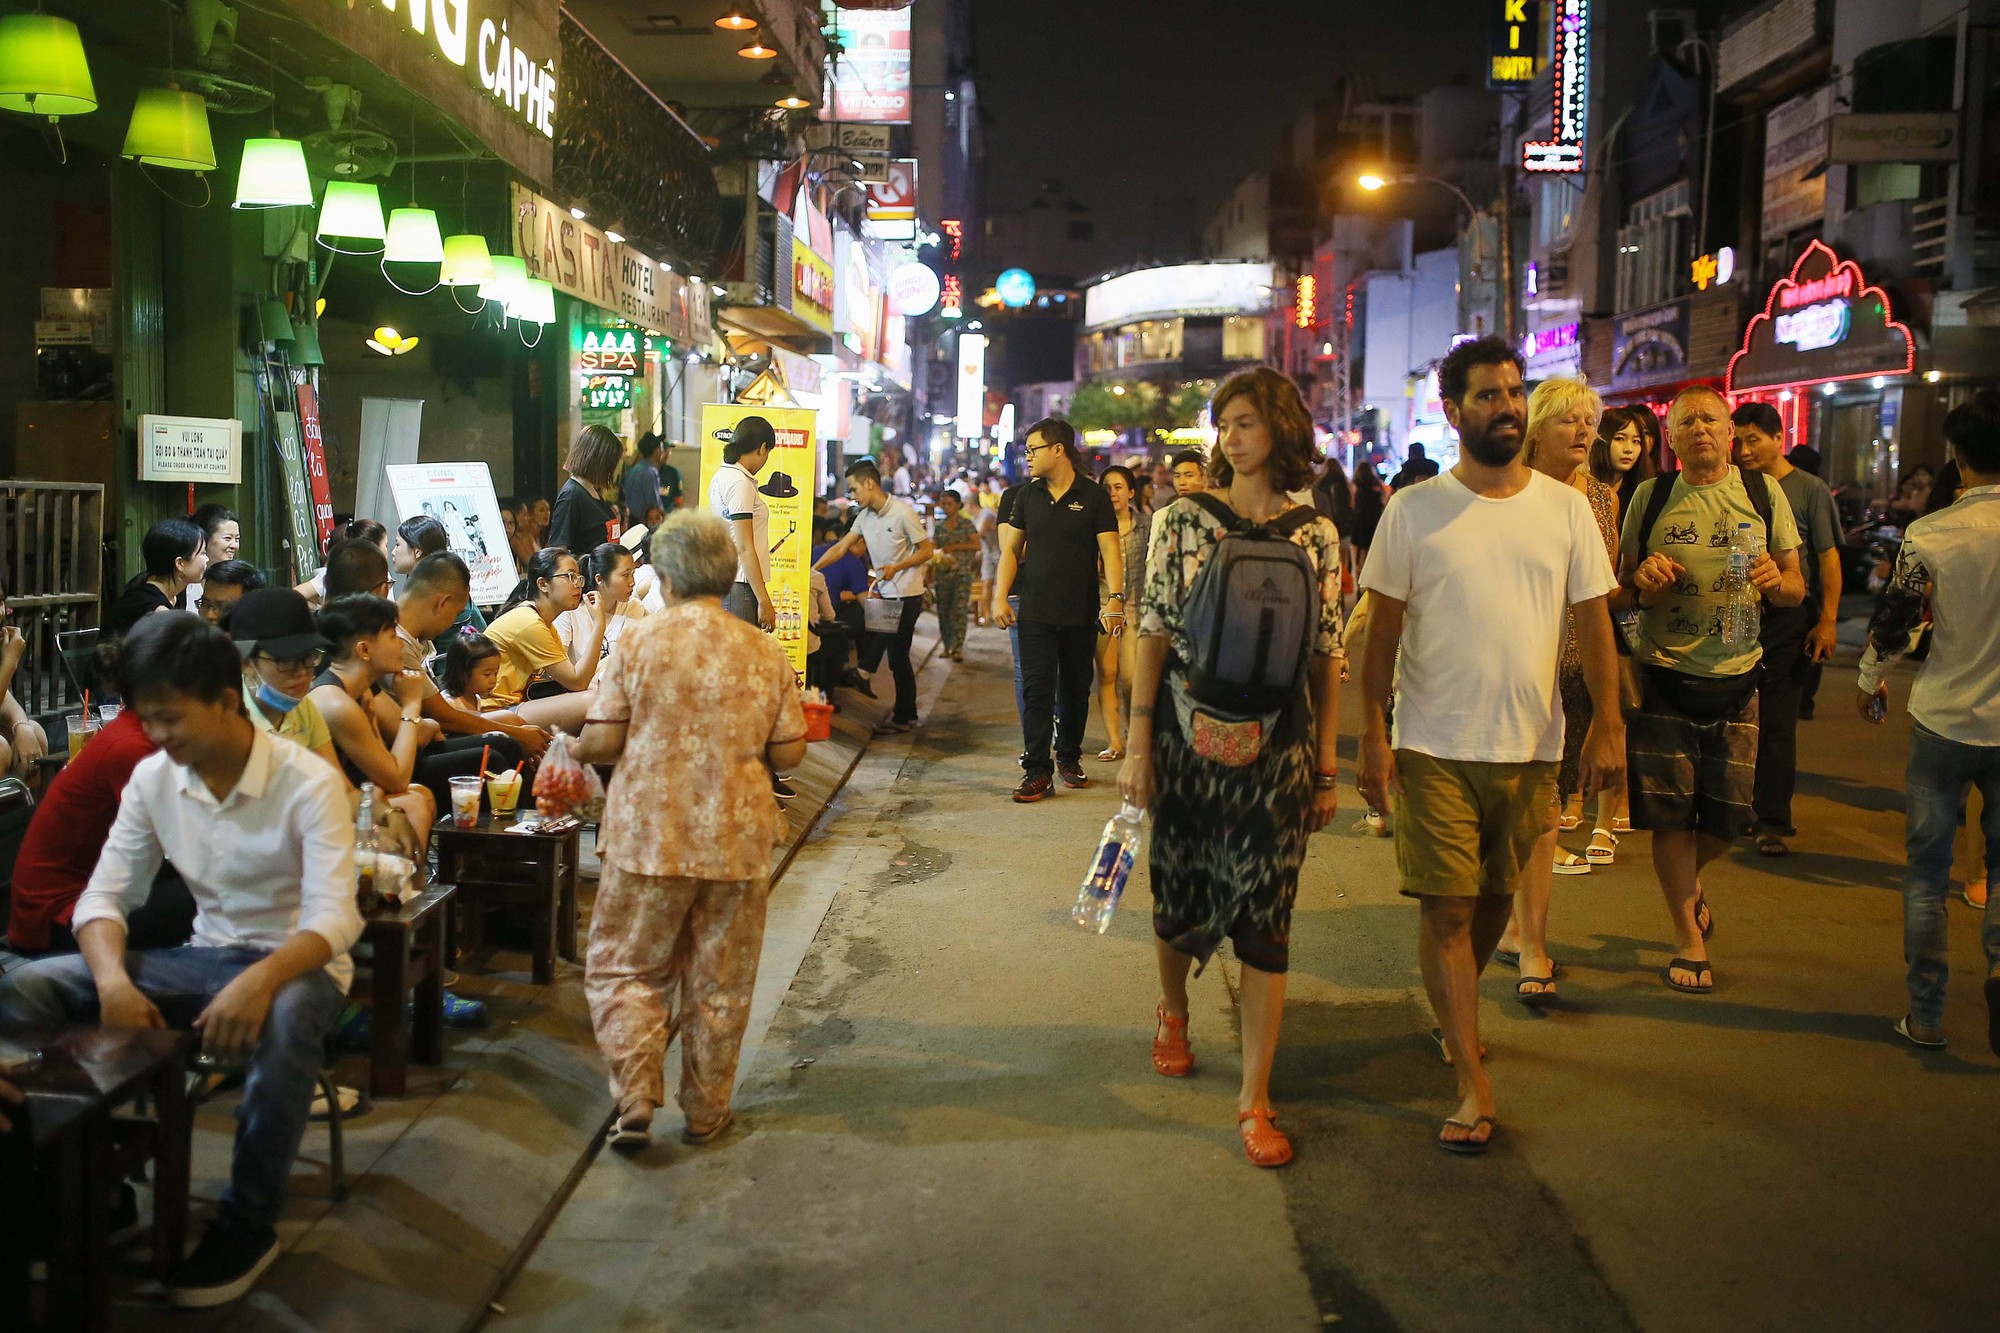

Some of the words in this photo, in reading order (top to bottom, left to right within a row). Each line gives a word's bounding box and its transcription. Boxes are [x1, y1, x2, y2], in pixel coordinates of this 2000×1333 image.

[622, 255, 654, 296] HOTEL
[621, 291, 670, 333] RESTAURANT
[583, 331, 636, 352] AAA
[581, 352, 637, 368] SPA
